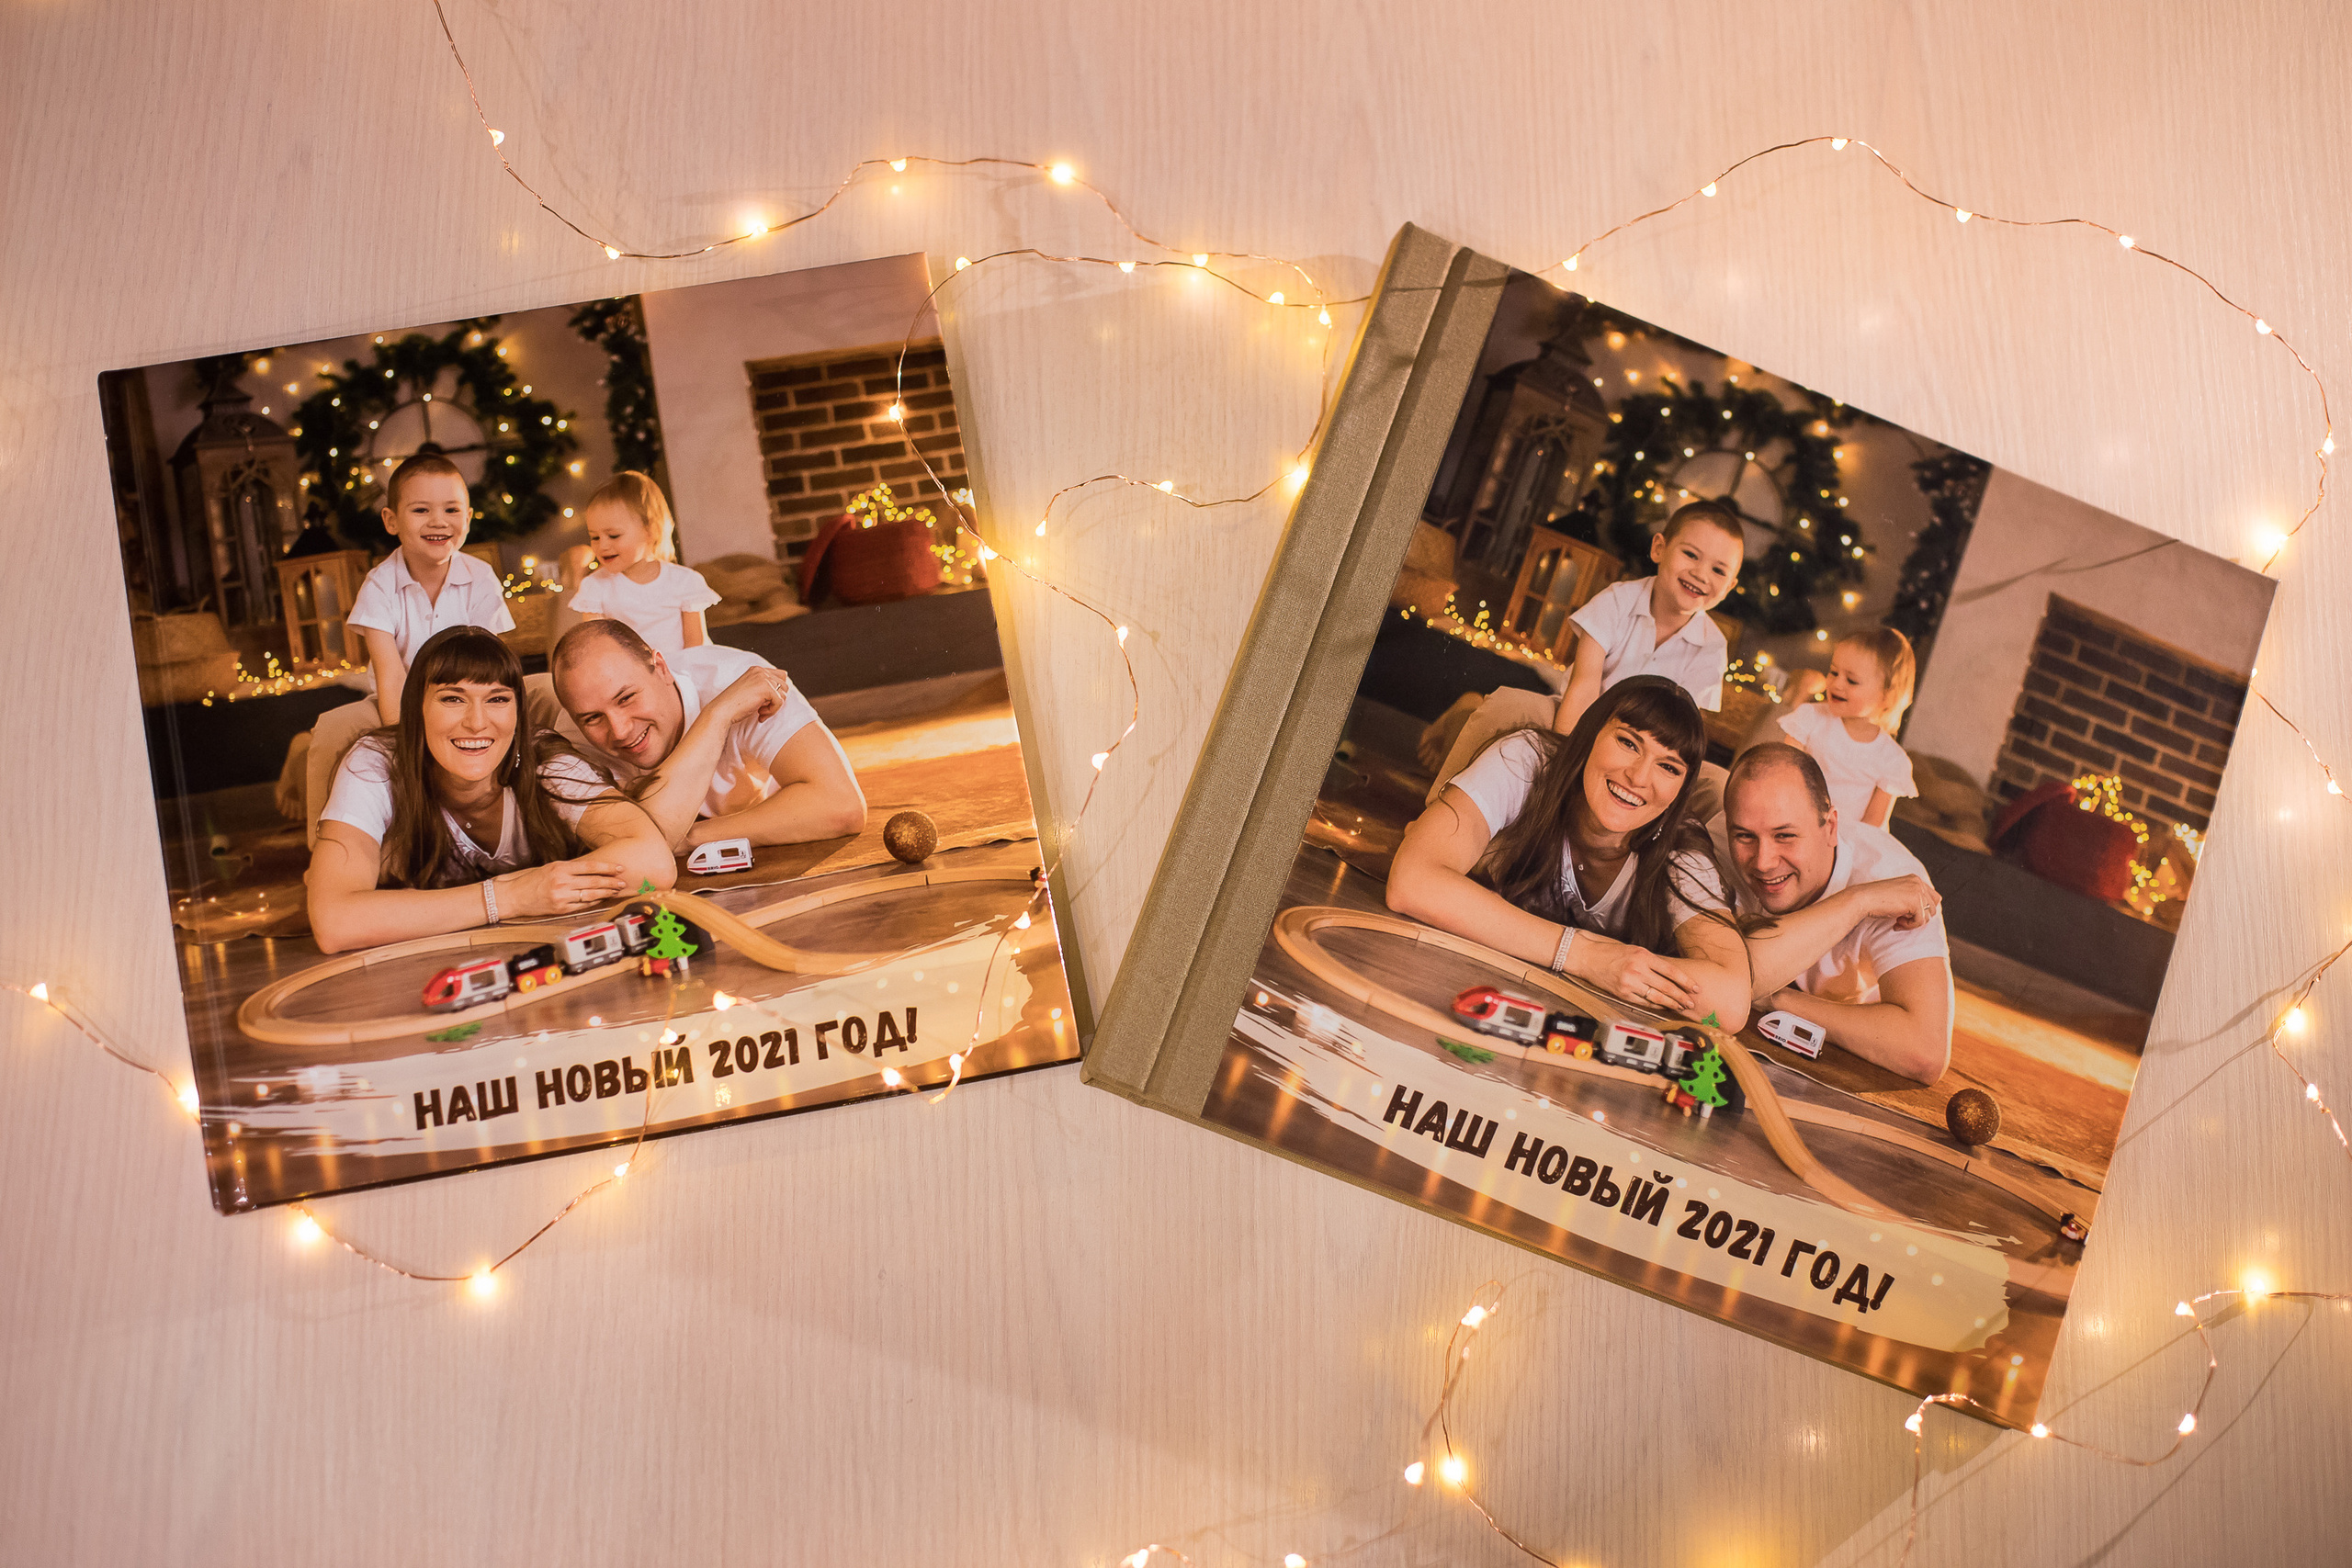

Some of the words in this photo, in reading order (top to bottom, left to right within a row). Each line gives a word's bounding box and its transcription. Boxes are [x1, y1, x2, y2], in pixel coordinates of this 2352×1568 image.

[413, 1076, 519, 1130] НАШ
[536, 1034, 695, 1109] НОВЫЙ
[709, 1028, 801, 1078] 2021
[815, 1007, 918, 1060] ГОД!
[1383, 1084, 1498, 1159] НАШ
[1504, 1132, 1674, 1227] НОВЫЙ
[1677, 1200, 1775, 1267] 2021
[1781, 1239, 1895, 1314] ГОД!
